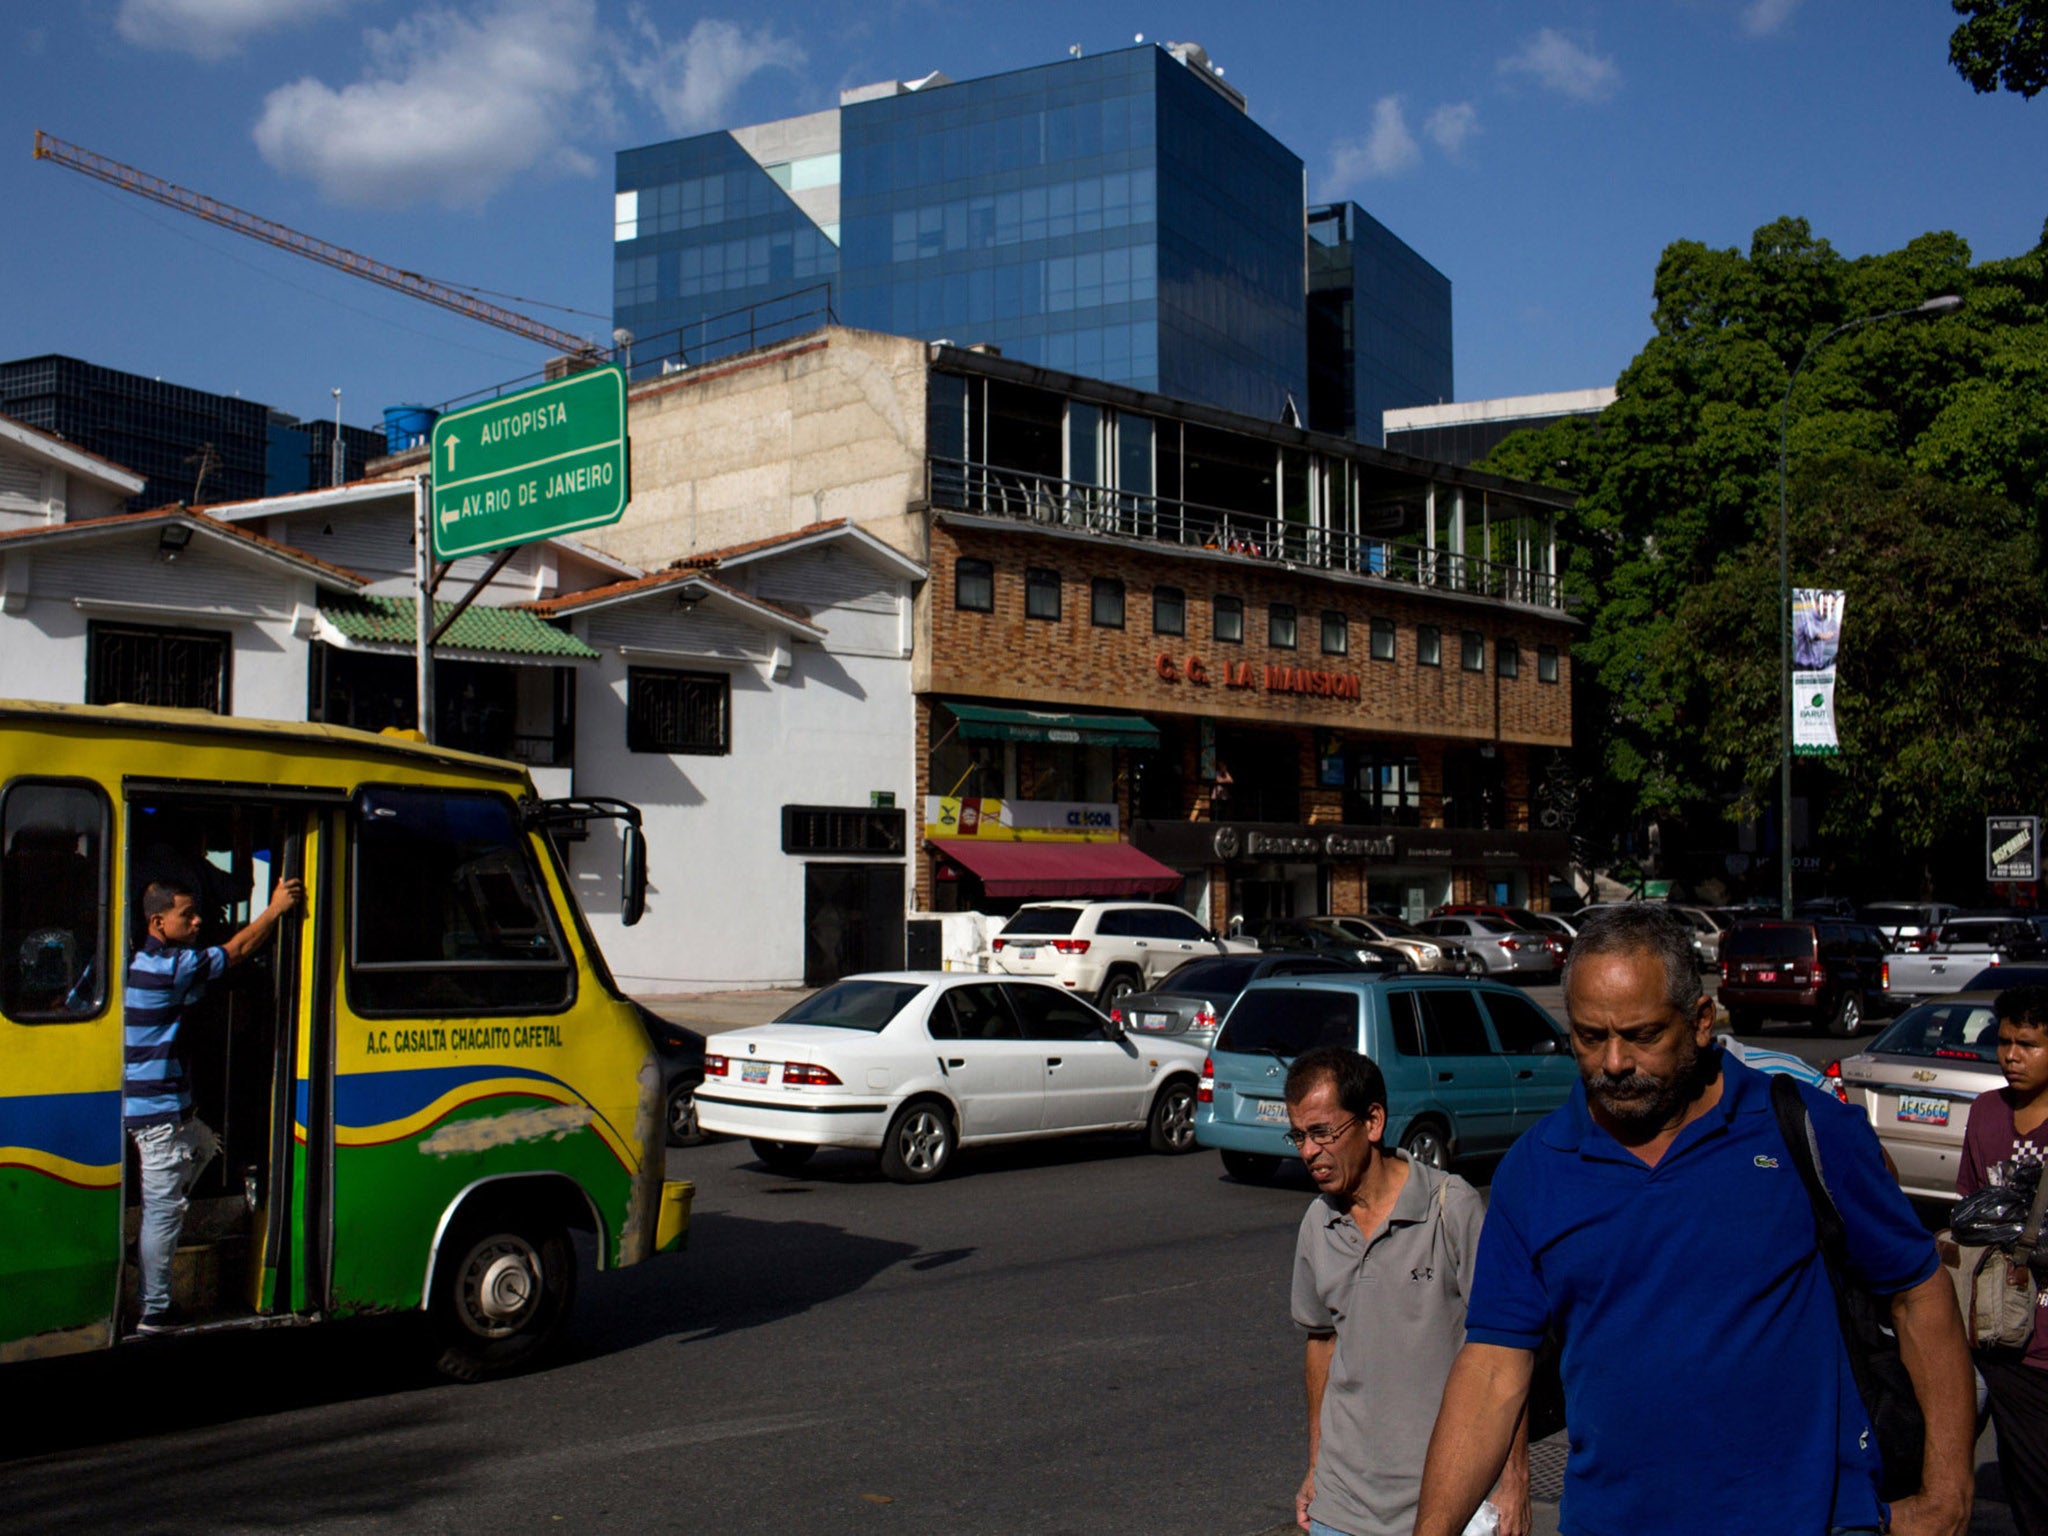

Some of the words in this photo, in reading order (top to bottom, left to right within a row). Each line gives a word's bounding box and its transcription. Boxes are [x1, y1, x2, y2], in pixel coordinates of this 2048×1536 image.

[481, 402, 567, 446] AUTOPISTA
[519, 481, 537, 506] DE
[546, 462, 613, 498] JANEIRO
[1223, 660, 1255, 690] LA
[1264, 664, 1360, 700] MANSION
[1248, 831, 1320, 855] Banco
[367, 1031, 391, 1054] A.C.
[394, 1029, 447, 1053] CASALTA
[451, 1027, 510, 1050] CHACAITO
[513, 1025, 563, 1048] CAFETAL
